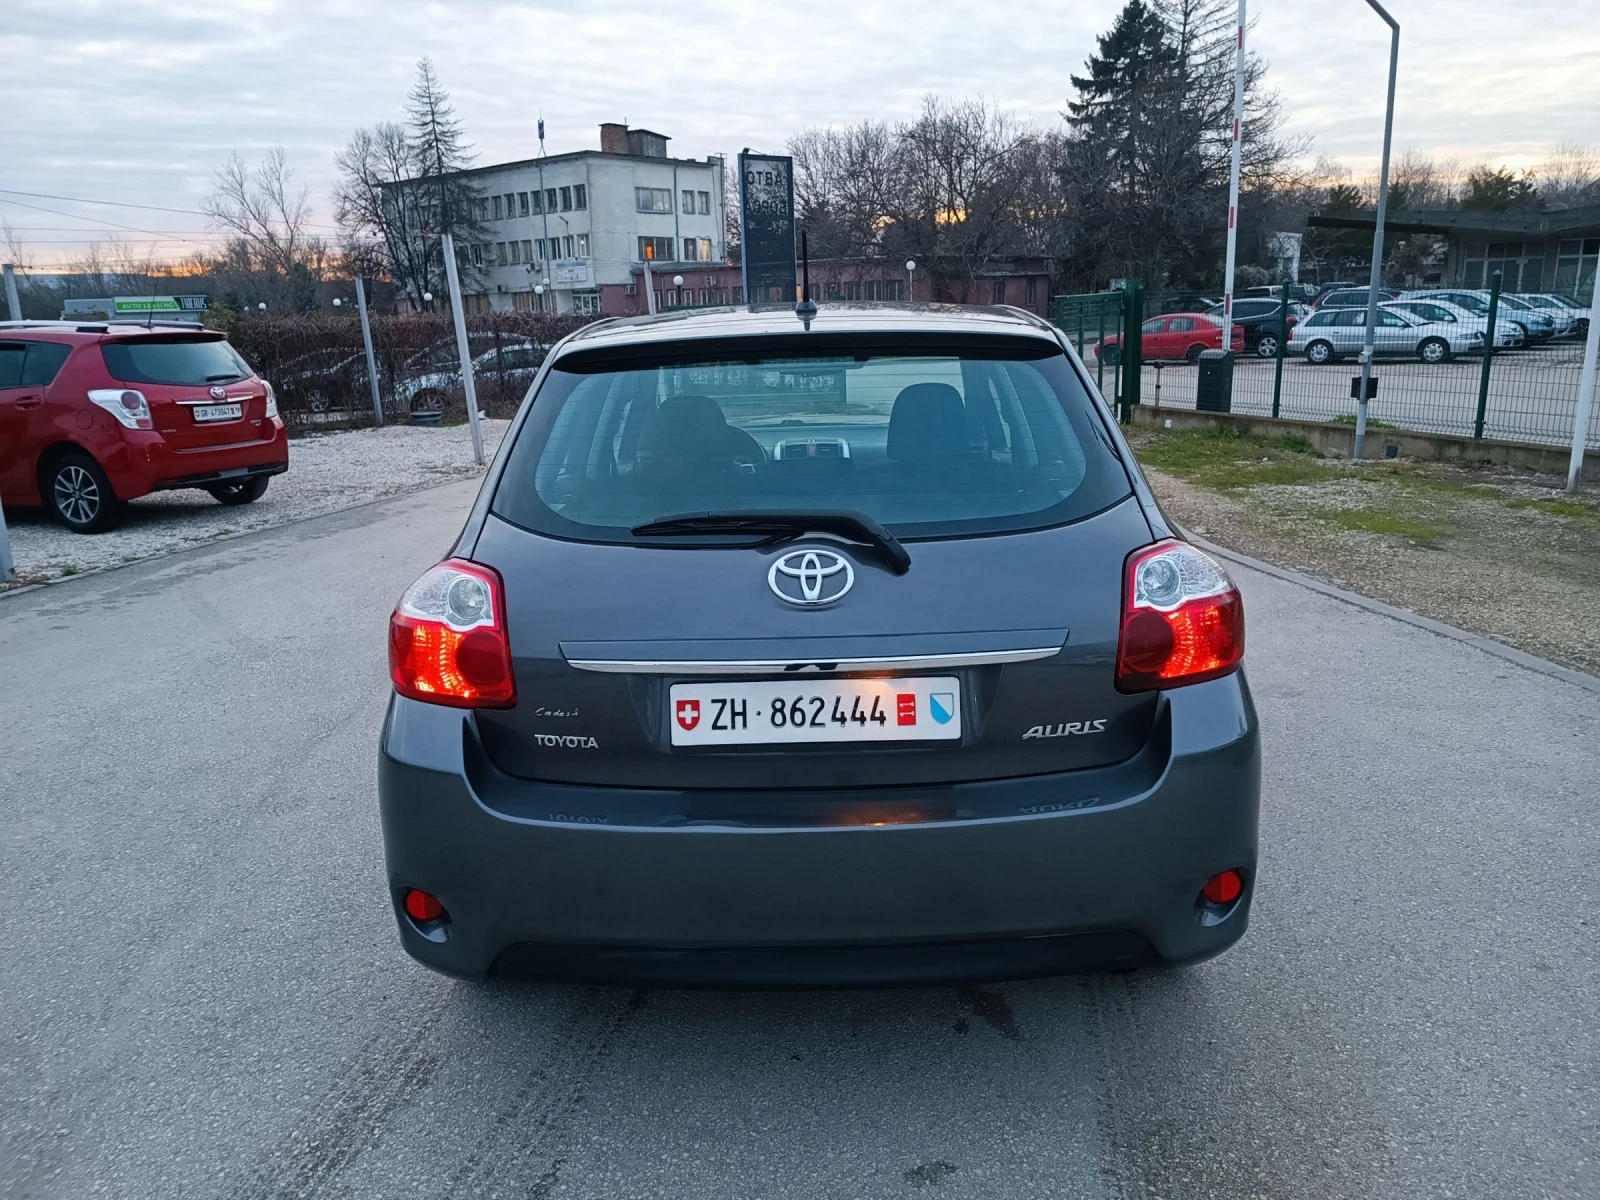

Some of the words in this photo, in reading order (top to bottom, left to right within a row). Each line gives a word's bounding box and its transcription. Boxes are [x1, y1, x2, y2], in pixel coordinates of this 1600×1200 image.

[769, 694, 887, 728] 862444
[1021, 719, 1108, 740] AURIS
[534, 734, 599, 749] TOYOTA
